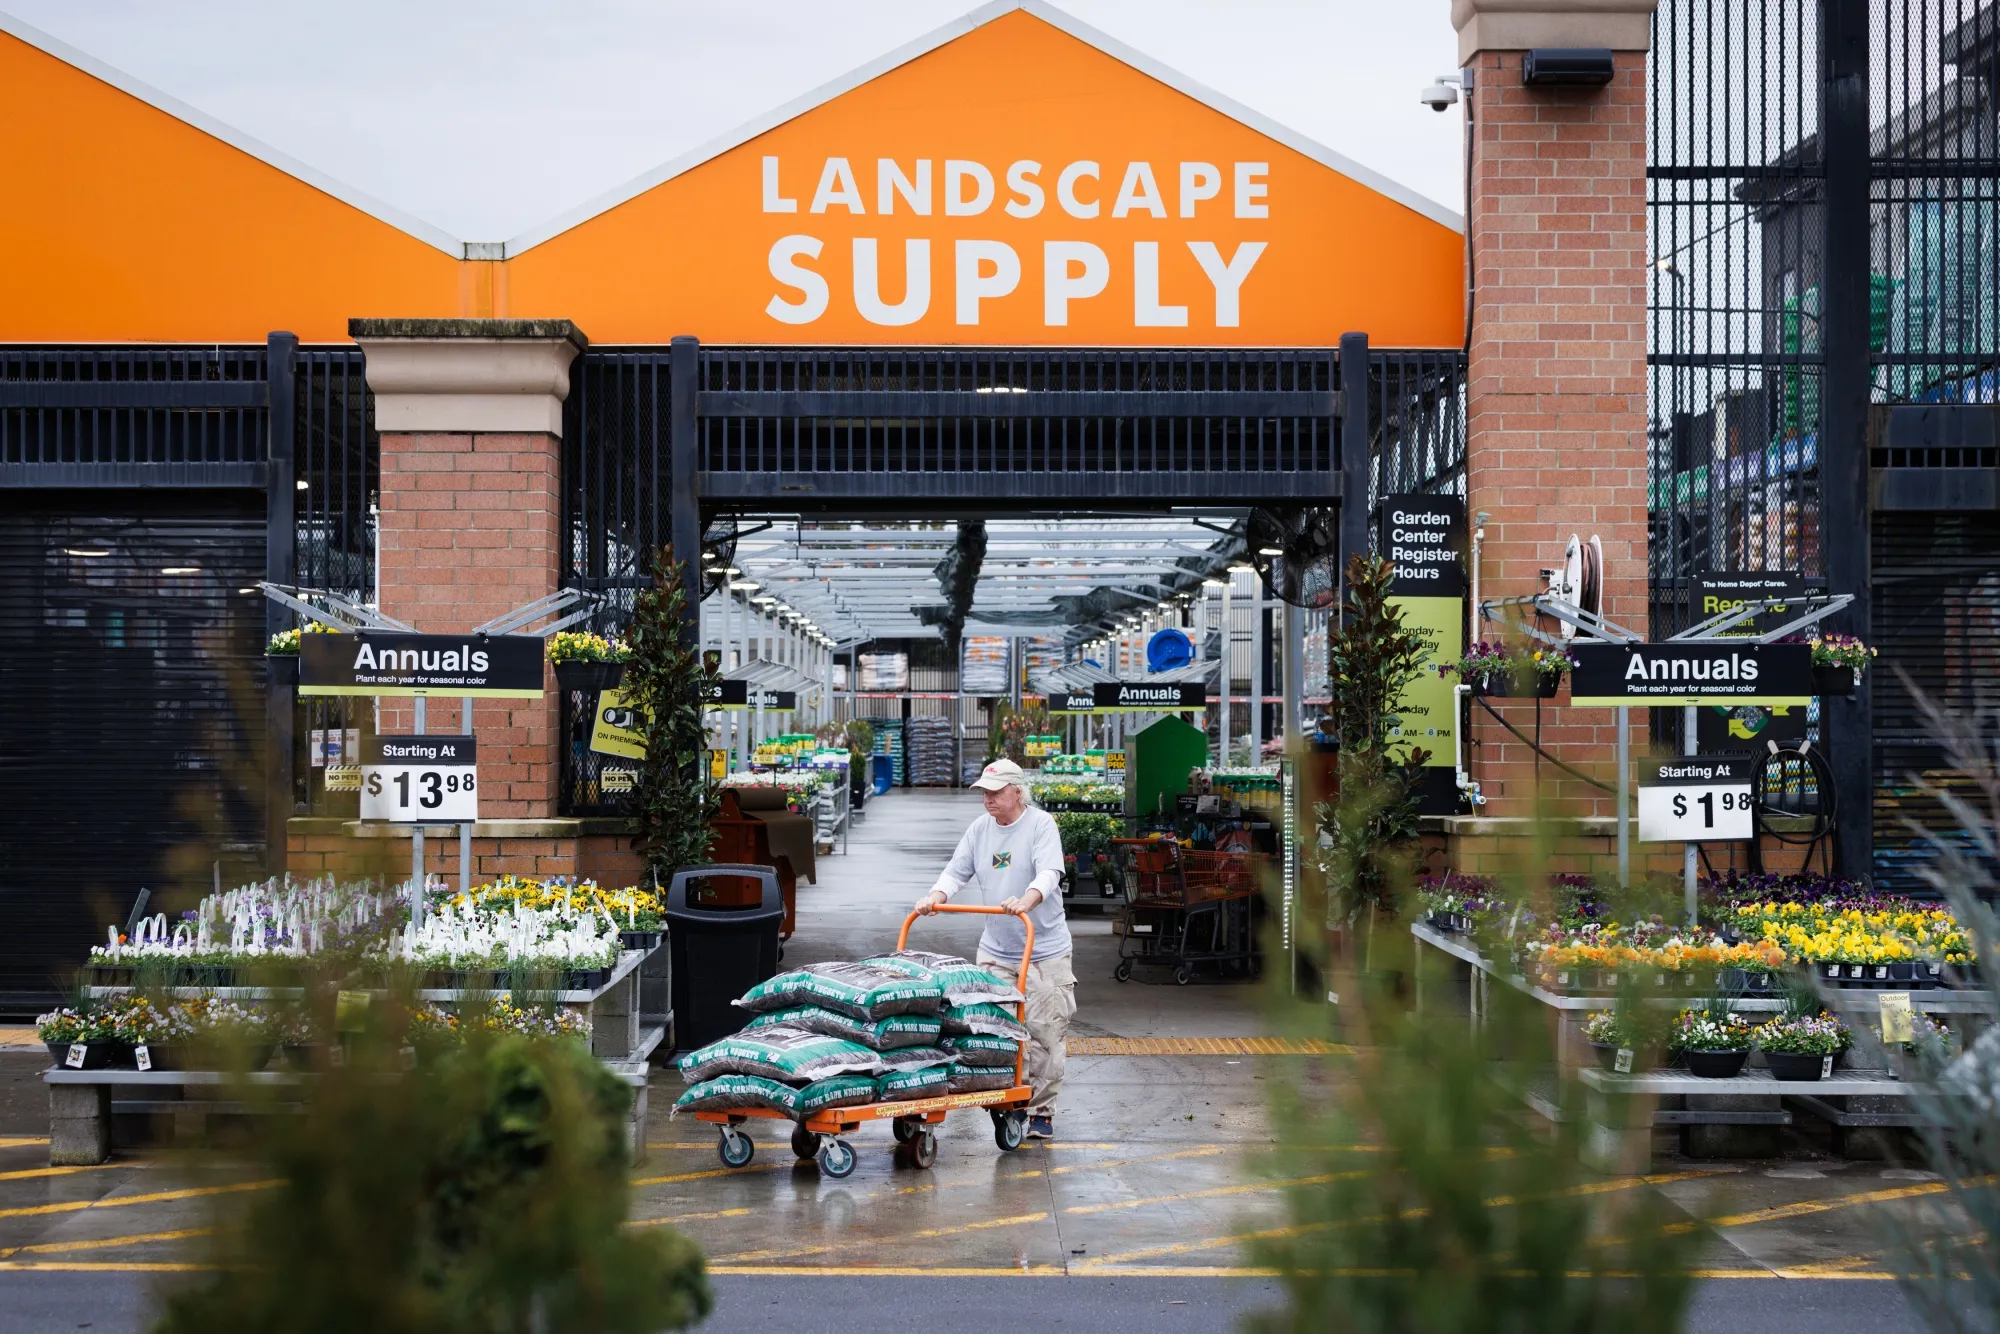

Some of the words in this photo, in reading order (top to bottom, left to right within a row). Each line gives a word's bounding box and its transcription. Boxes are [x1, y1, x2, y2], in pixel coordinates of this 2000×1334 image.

[762, 155, 1269, 220] LANDSCAPE
[765, 233, 1268, 327] SUPPLY
[1392, 510, 1451, 525] Garden
[1392, 529, 1446, 543] Center
[1392, 547, 1458, 564] Register
[1392, 565, 1440, 579] Hours
[1703, 595, 1787, 614] Recle
[353, 643, 489, 672] Annuals
[1625, 653, 1759, 680] Annuals
[355, 674, 375, 682] Plant
[377, 675, 397, 683] each
[398, 676, 416, 685] year
[417, 676, 429, 684] for
[429, 676, 465, 684] seasonal
[466, 677, 487, 685] color
[1118, 686, 1181, 700] Annuals
[1669, 685, 1687, 694] year
[1736, 685, 1757, 693] color
[1067, 696, 1094, 706] Annu
[598, 732, 608, 740] ON
[383, 745, 437, 759] Starting
[440, 745, 456, 757] At
[1659, 765, 1712, 779] Starting
[1716, 765, 1731, 776] At
[813, 982, 846, 1000] NUGGETS
[876, 992, 895, 1004] PINE
[896, 990, 914, 1000] BARK
[914, 989, 941, 998] NUGGETS
[782, 1011, 801, 1021] PINE
[817, 1009, 854, 1027] NUGGETS
[887, 1023, 903, 1032] PINE
[903, 1023, 918, 1032] BARK
[968, 1040, 984, 1048] PINE
[999, 1044, 1019, 1052] NUGGET
[698, 1052, 714, 1063] PINE
[713, 1085, 731, 1095] PINE
[887, 1080, 905, 1089] PINE
[905, 1077, 922, 1087] BARK
[804, 1097, 823, 1108] PINE
[824, 1090, 842, 1101] BARK
[843, 1086, 872, 1097] NUGGETS
